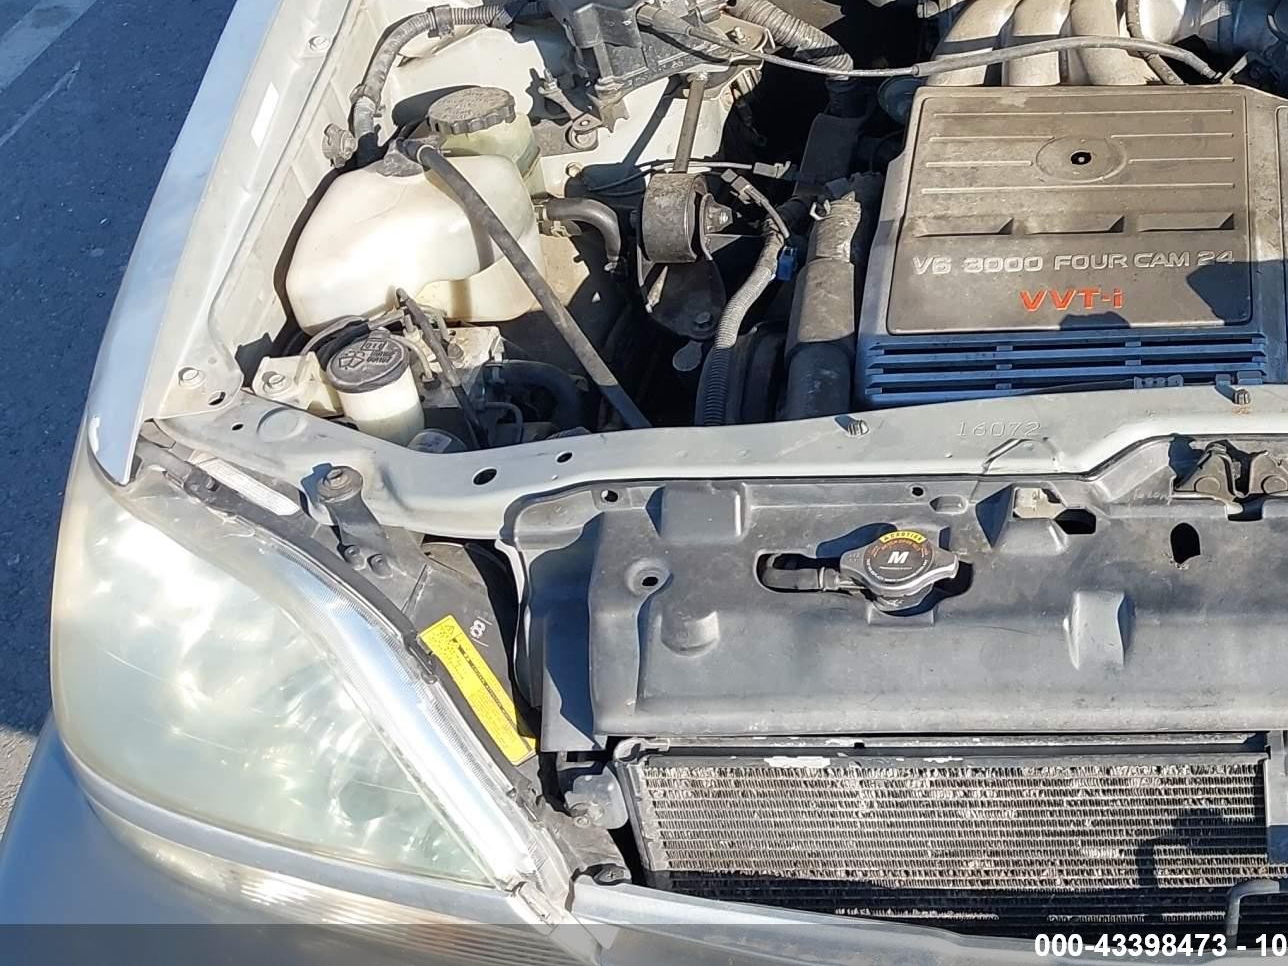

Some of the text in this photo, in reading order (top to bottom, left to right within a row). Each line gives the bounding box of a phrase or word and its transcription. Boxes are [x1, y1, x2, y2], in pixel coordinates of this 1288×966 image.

[912, 249, 1235, 274] V6 3000 FOUR CAM 24
[1019, 288, 1126, 312] VVT-i
[957, 420, 1041, 437] 16072
[888, 550, 910, 564] M
[470, 619, 486, 639] 8
